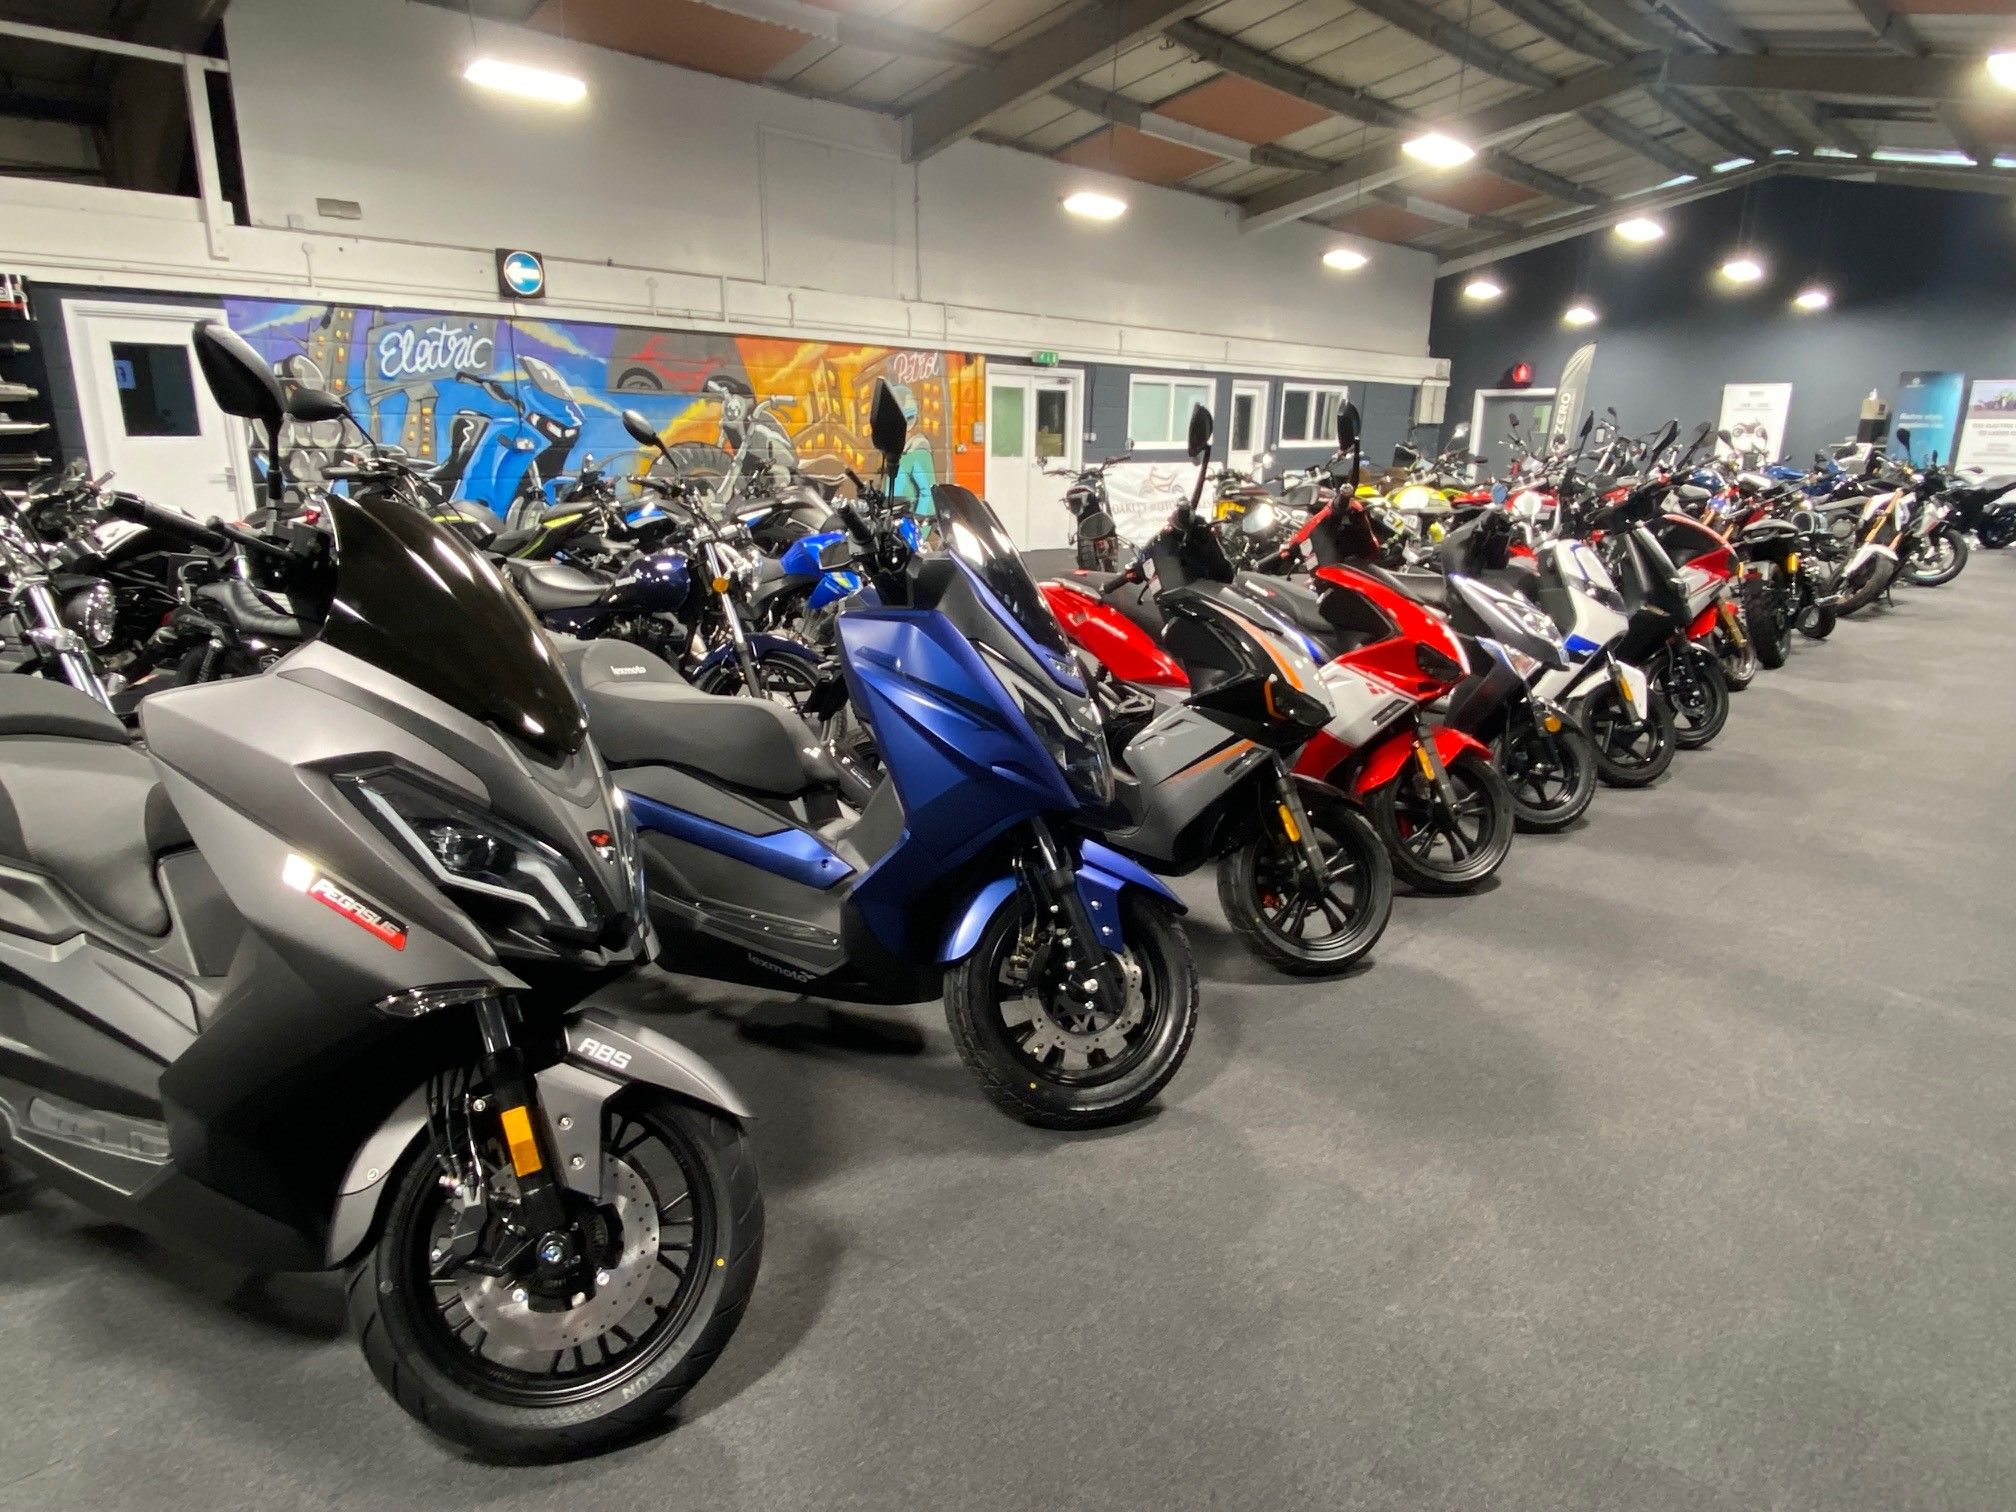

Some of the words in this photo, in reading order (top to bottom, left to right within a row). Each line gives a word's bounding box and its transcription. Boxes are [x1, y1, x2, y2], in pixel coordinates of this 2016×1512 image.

[379, 321, 494, 378] Electric
[893, 351, 940, 384] Petrol
[1553, 392, 1571, 434] ZERO
[309, 878, 401, 938] PEGASUS
[577, 1037, 632, 1070] ABS
